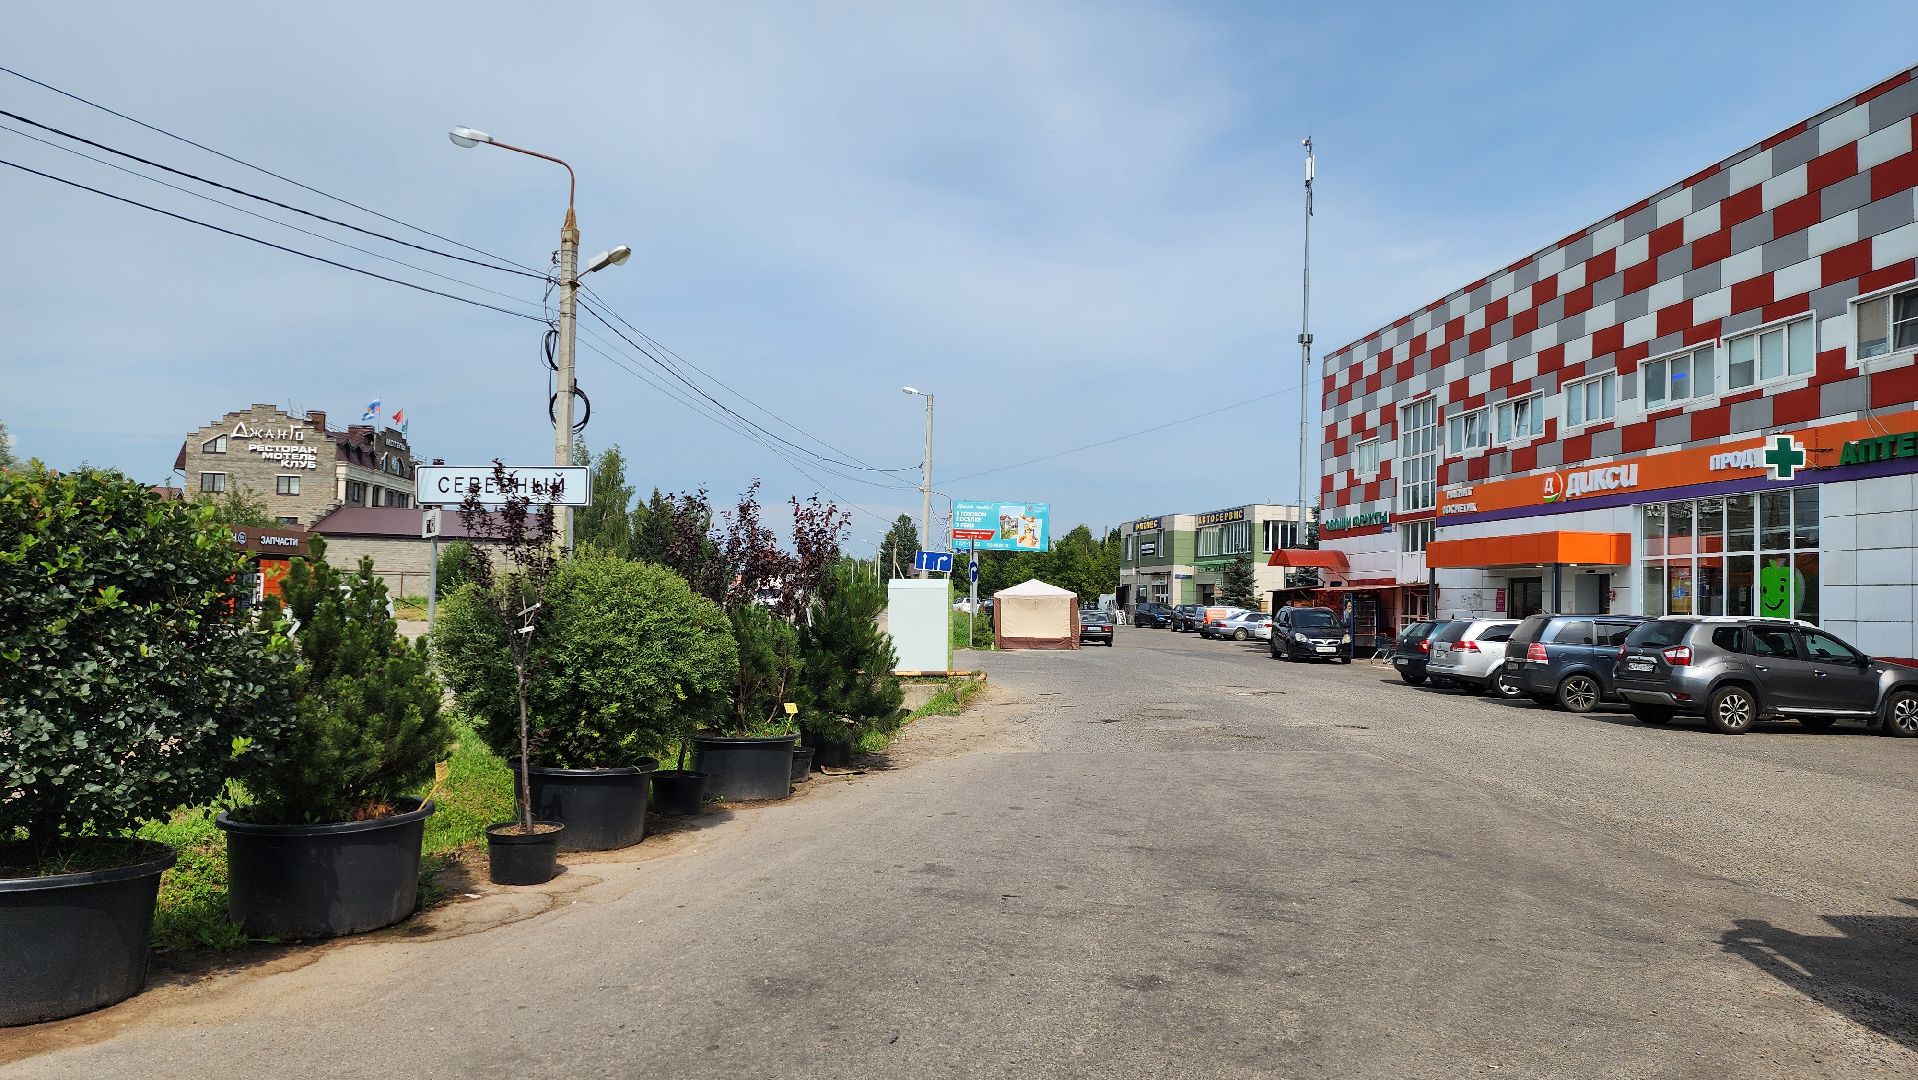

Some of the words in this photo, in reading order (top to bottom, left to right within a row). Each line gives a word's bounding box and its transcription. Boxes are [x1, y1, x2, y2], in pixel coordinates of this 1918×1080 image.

[248, 443, 317, 454] РЕСТОРАН
[262, 451, 317, 461] МОТЕЛЬ
[280, 459, 317, 469] КЛУБ
[1565, 463, 1639, 498] ДИКСИ
[1198, 510, 1244, 526] АВТОСЕРВИС
[260, 535, 299, 547] ЗАПЧАСТИ
